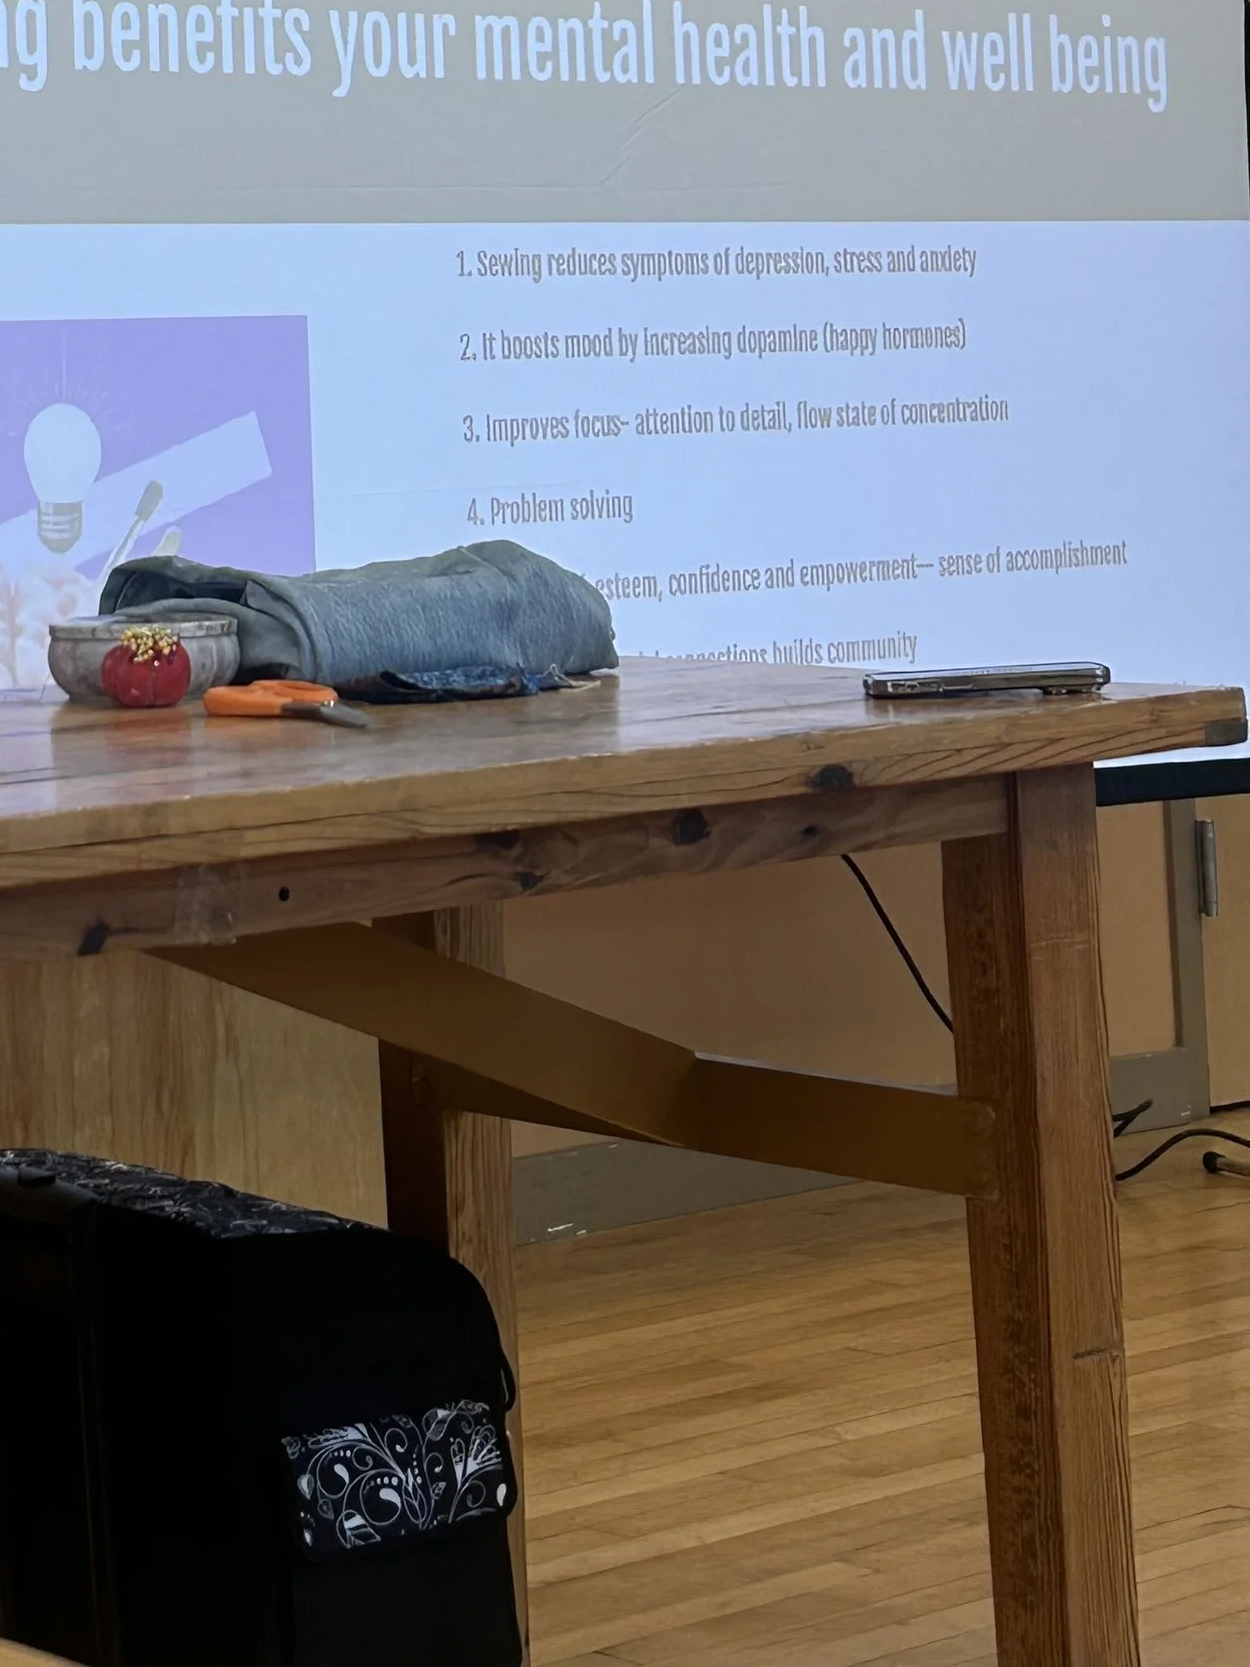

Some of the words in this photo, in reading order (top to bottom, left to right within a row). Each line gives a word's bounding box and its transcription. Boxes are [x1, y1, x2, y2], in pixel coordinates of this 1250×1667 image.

[330, 8, 456, 98] your
[475, 0, 656, 85] mental
[672, 0, 827, 89] health
[843, 9, 926, 90] and
[941, 12, 1034, 92] well
[1049, 14, 1168, 113] being
[456, 250, 472, 277] 1.
[477, 248, 542, 284] Sewing
[548, 247, 617, 276] reduces
[621, 250, 710, 282] symptoms
[713, 247, 731, 275] of
[735, 246, 831, 280] depression,
[833, 248, 883, 274] stress
[887, 245, 916, 273] and
[919, 244, 977, 278] anxiety
[459, 333, 478, 361] 2.
[482, 332, 497, 360] It
[501, 330, 560, 359] boosts
[564, 328, 614, 358] mood
[618, 328, 639, 362] by
[643, 326, 732, 360] increasing
[736, 324, 819, 359] dopamine
[823, 321, 878, 356] (happy
[882, 318, 967, 350] hormones)
[462, 415, 481, 443] 3.
[486, 414, 570, 447] Improves
[574, 408, 629, 438] focus-
[635, 405, 714, 435] attention
[719, 406, 736, 433] to
[740, 403, 793, 433] detail,
[797, 401, 832, 429] flow
[836, 401, 877, 427] state
[881, 398, 897, 425] of
[901, 394, 1009, 425] concentration
[467, 498, 485, 526] 4.
[490, 493, 565, 526] Problem
[570, 489, 634, 524] solving
[668, 563, 761, 597] confidence
[764, 558, 795, 589] and
[938, 553, 983, 577] sense
[986, 545, 1001, 574] of
[1005, 539, 1128, 575] accomplishment
[827, 630, 918, 665] community
